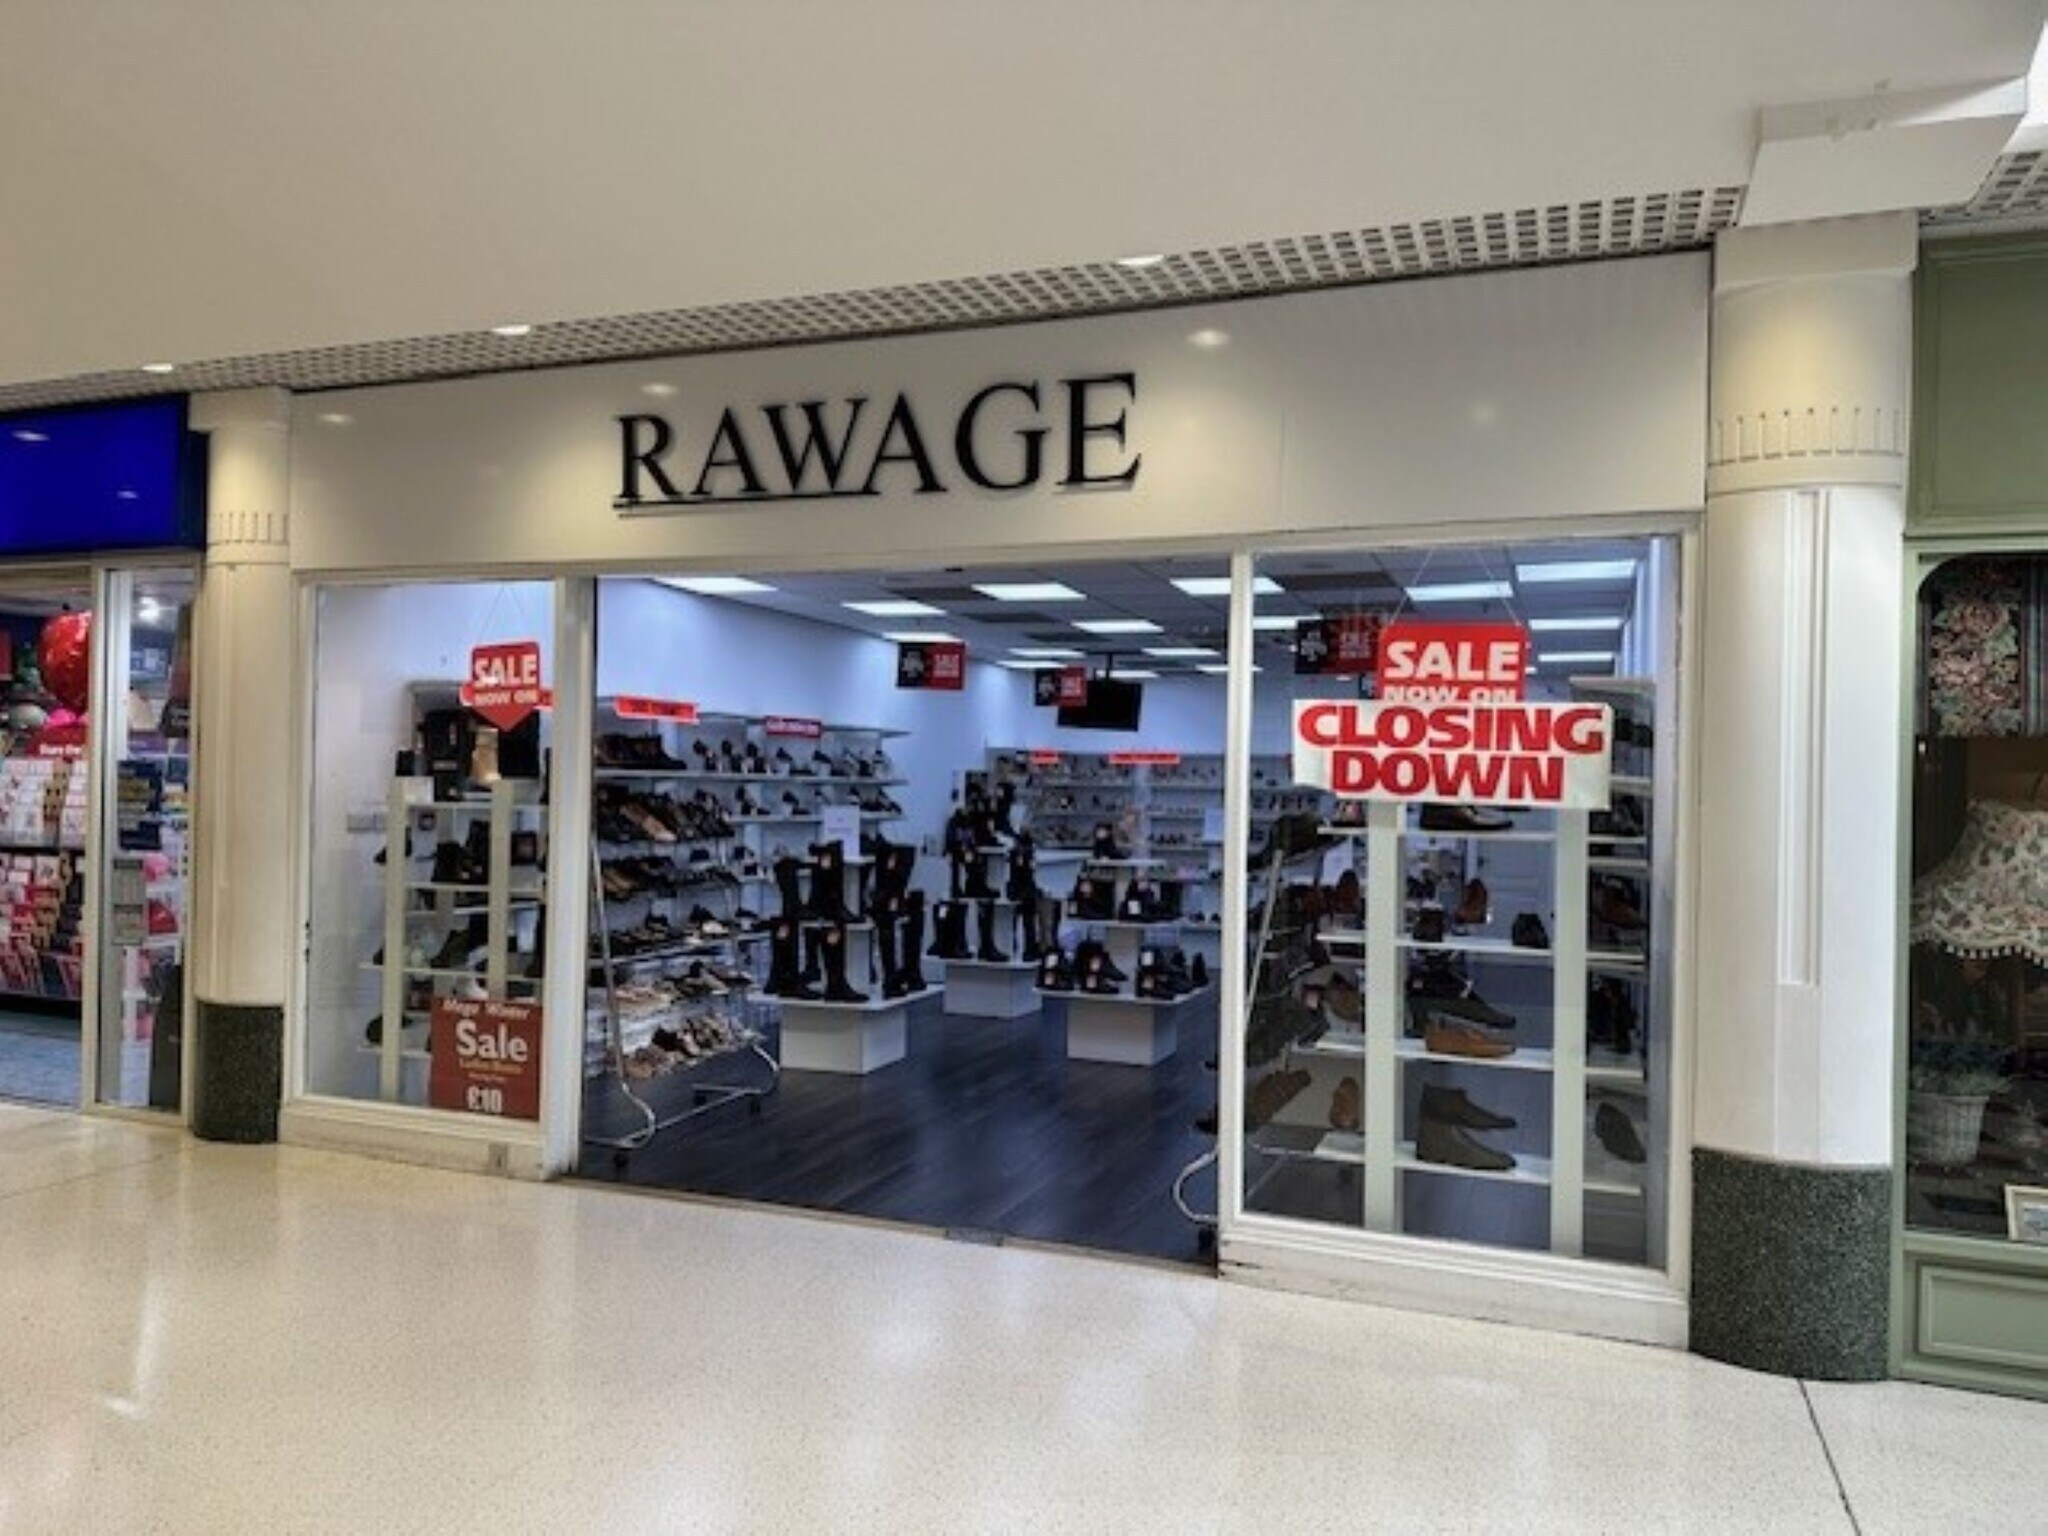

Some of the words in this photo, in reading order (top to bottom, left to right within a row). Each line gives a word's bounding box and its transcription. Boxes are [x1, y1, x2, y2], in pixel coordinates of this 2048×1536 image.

[613, 372, 1142, 506] RAWAGE
[474, 654, 538, 688] SALE
[1384, 641, 1521, 682] SALE
[474, 691, 511, 706] NOW
[514, 689, 538, 704] ON
[1384, 685, 1458, 702] NOW
[1468, 685, 1517, 704] ON
[1299, 703, 1605, 755] CLOSING
[1331, 750, 1565, 801] DOWN
[456, 1020, 528, 1062] Sale
